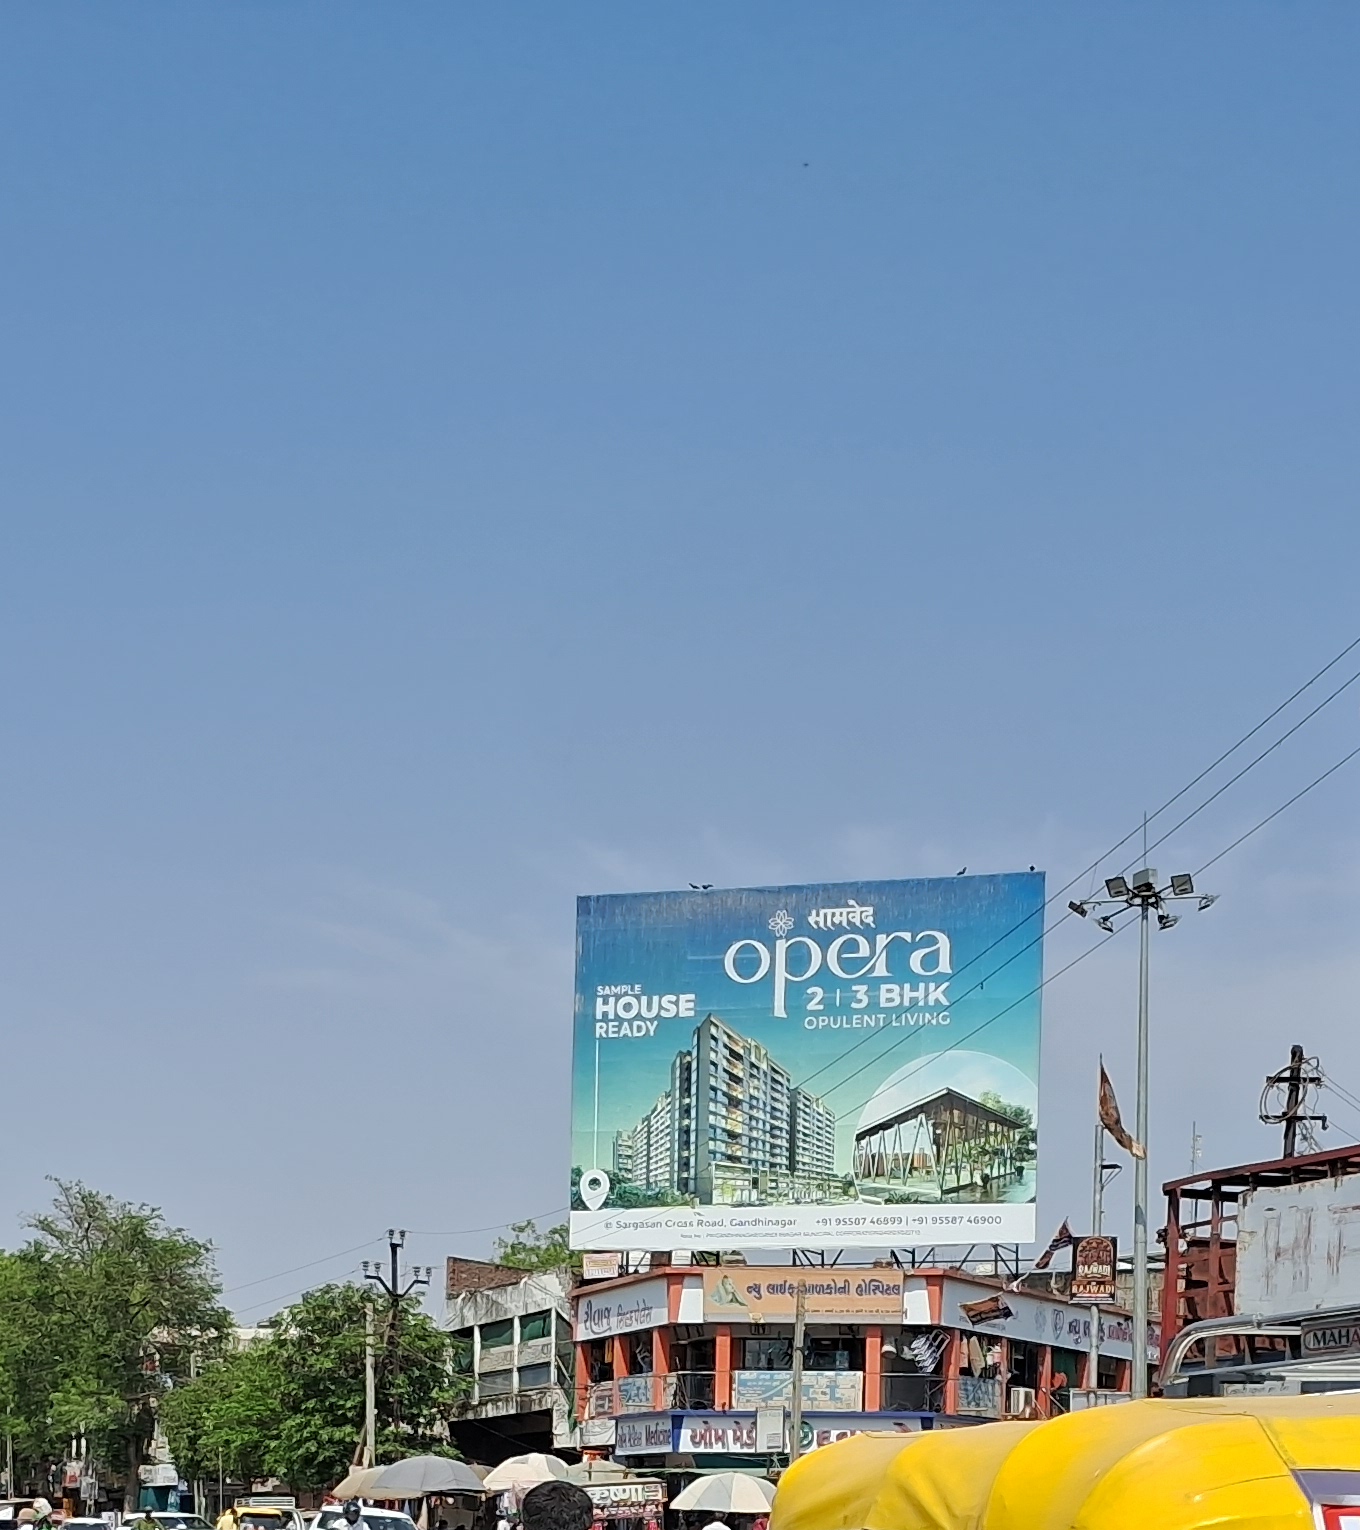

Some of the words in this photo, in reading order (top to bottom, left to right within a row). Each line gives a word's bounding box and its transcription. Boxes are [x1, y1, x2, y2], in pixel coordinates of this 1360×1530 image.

[808, 901, 875, 930] सामवेद
[724, 930, 953, 1018] opera
[596, 985, 642, 996] SAMPLE
[806, 986, 824, 1010] 2
[851, 983, 867, 1009] 3
[879, 981, 951, 1008] BHK
[595, 994, 696, 1019] HOUSE
[595, 1021, 658, 1038] READY
[804, 1014, 886, 1030] OPULENT
[892, 1011, 951, 1028] LIVING
[615, 1218, 663, 1231] Sargasan
[665, 1218, 694, 1229] Cross
[696, 1217, 727, 1229] Road,
[729, 1217, 798, 1229] Gandhinagar
[966, 1215, 1002, 1226] 46900
[1071, 1283, 1115, 1295] RAJWADI
